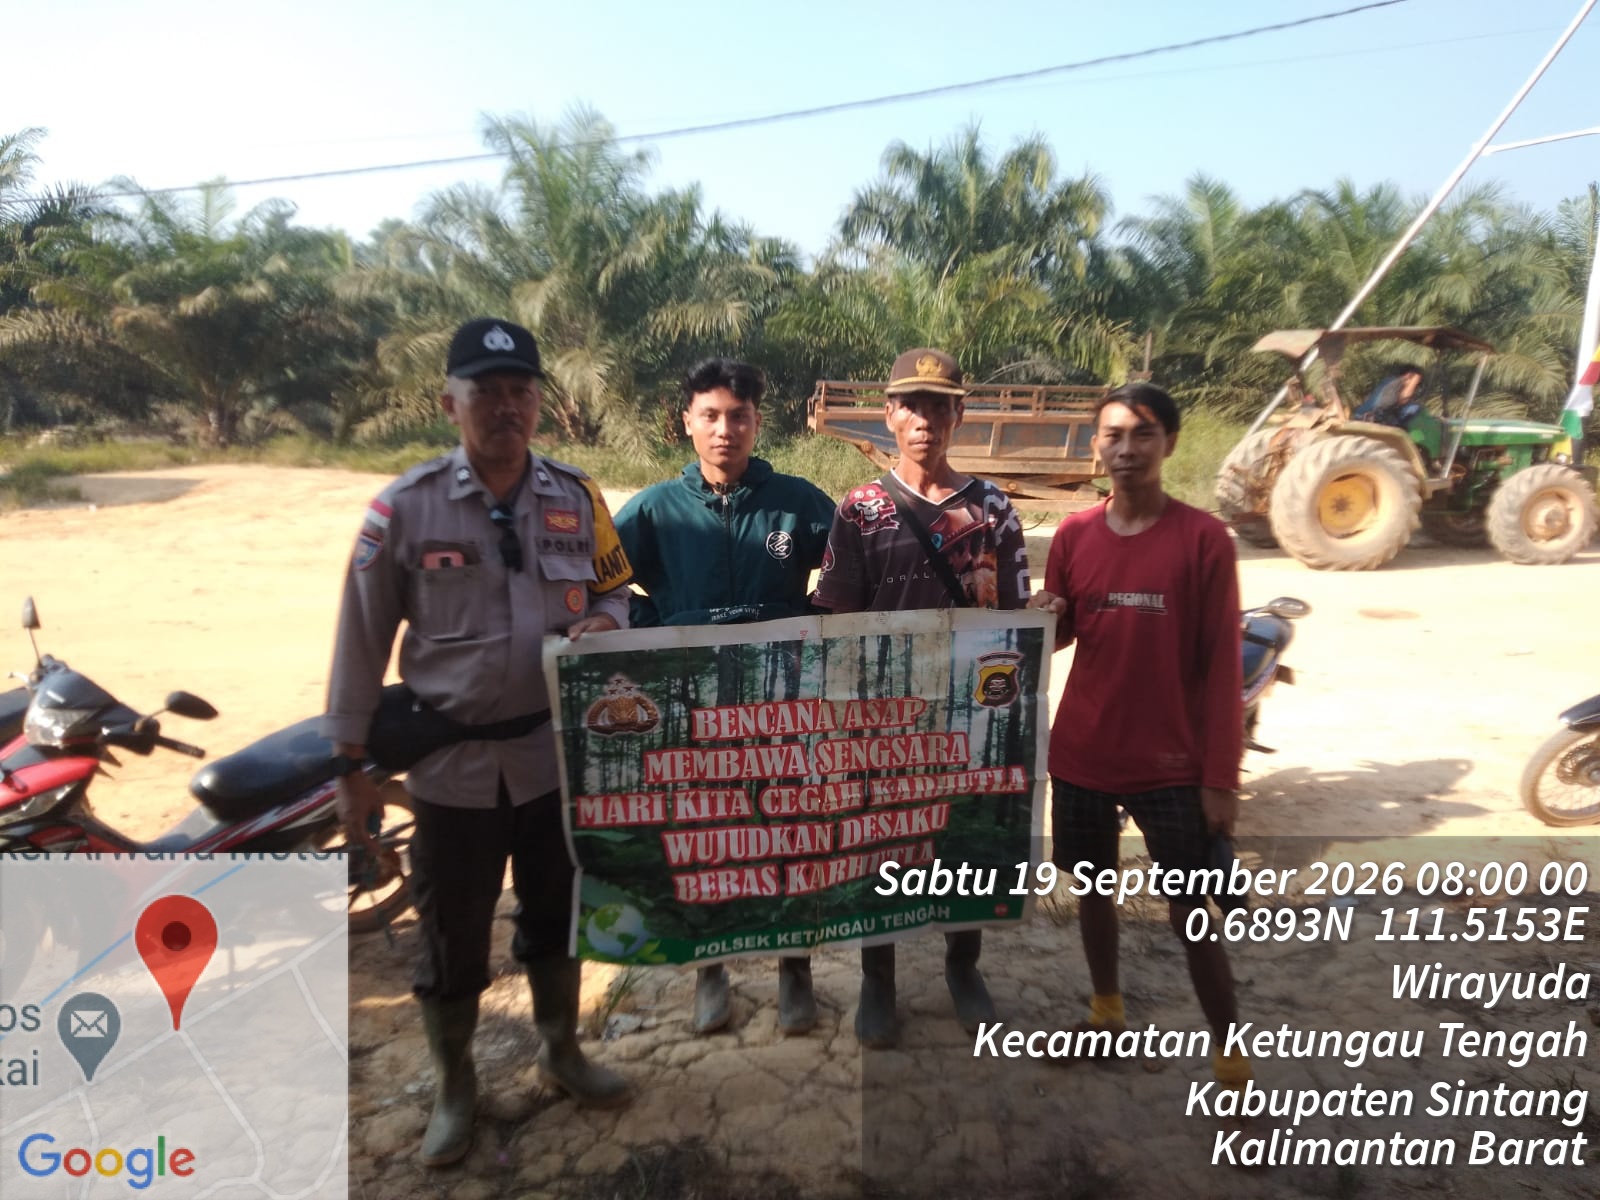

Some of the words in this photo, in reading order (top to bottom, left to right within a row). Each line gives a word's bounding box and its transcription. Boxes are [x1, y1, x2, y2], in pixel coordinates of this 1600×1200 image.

[694, 699, 834, 739] BENCANA
[844, 699, 925, 729] ASAP
[646, 745, 808, 782] MEMBAWA
[817, 734, 968, 773] SENGSARA
[578, 792, 665, 826] MARI
[674, 790, 750, 821] KITA
[761, 782, 861, 814] CEGAH
[871, 767, 1026, 805] KARHUTLA
[664, 823, 833, 865] WUJUDKAN
[842, 804, 948, 848] DESAKU
[676, 868, 778, 900] BEBAS
[695, 933, 771, 958] POLSEK
[778, 917, 877, 947] KETUNGAU
[882, 905, 951, 930] TENGAH
